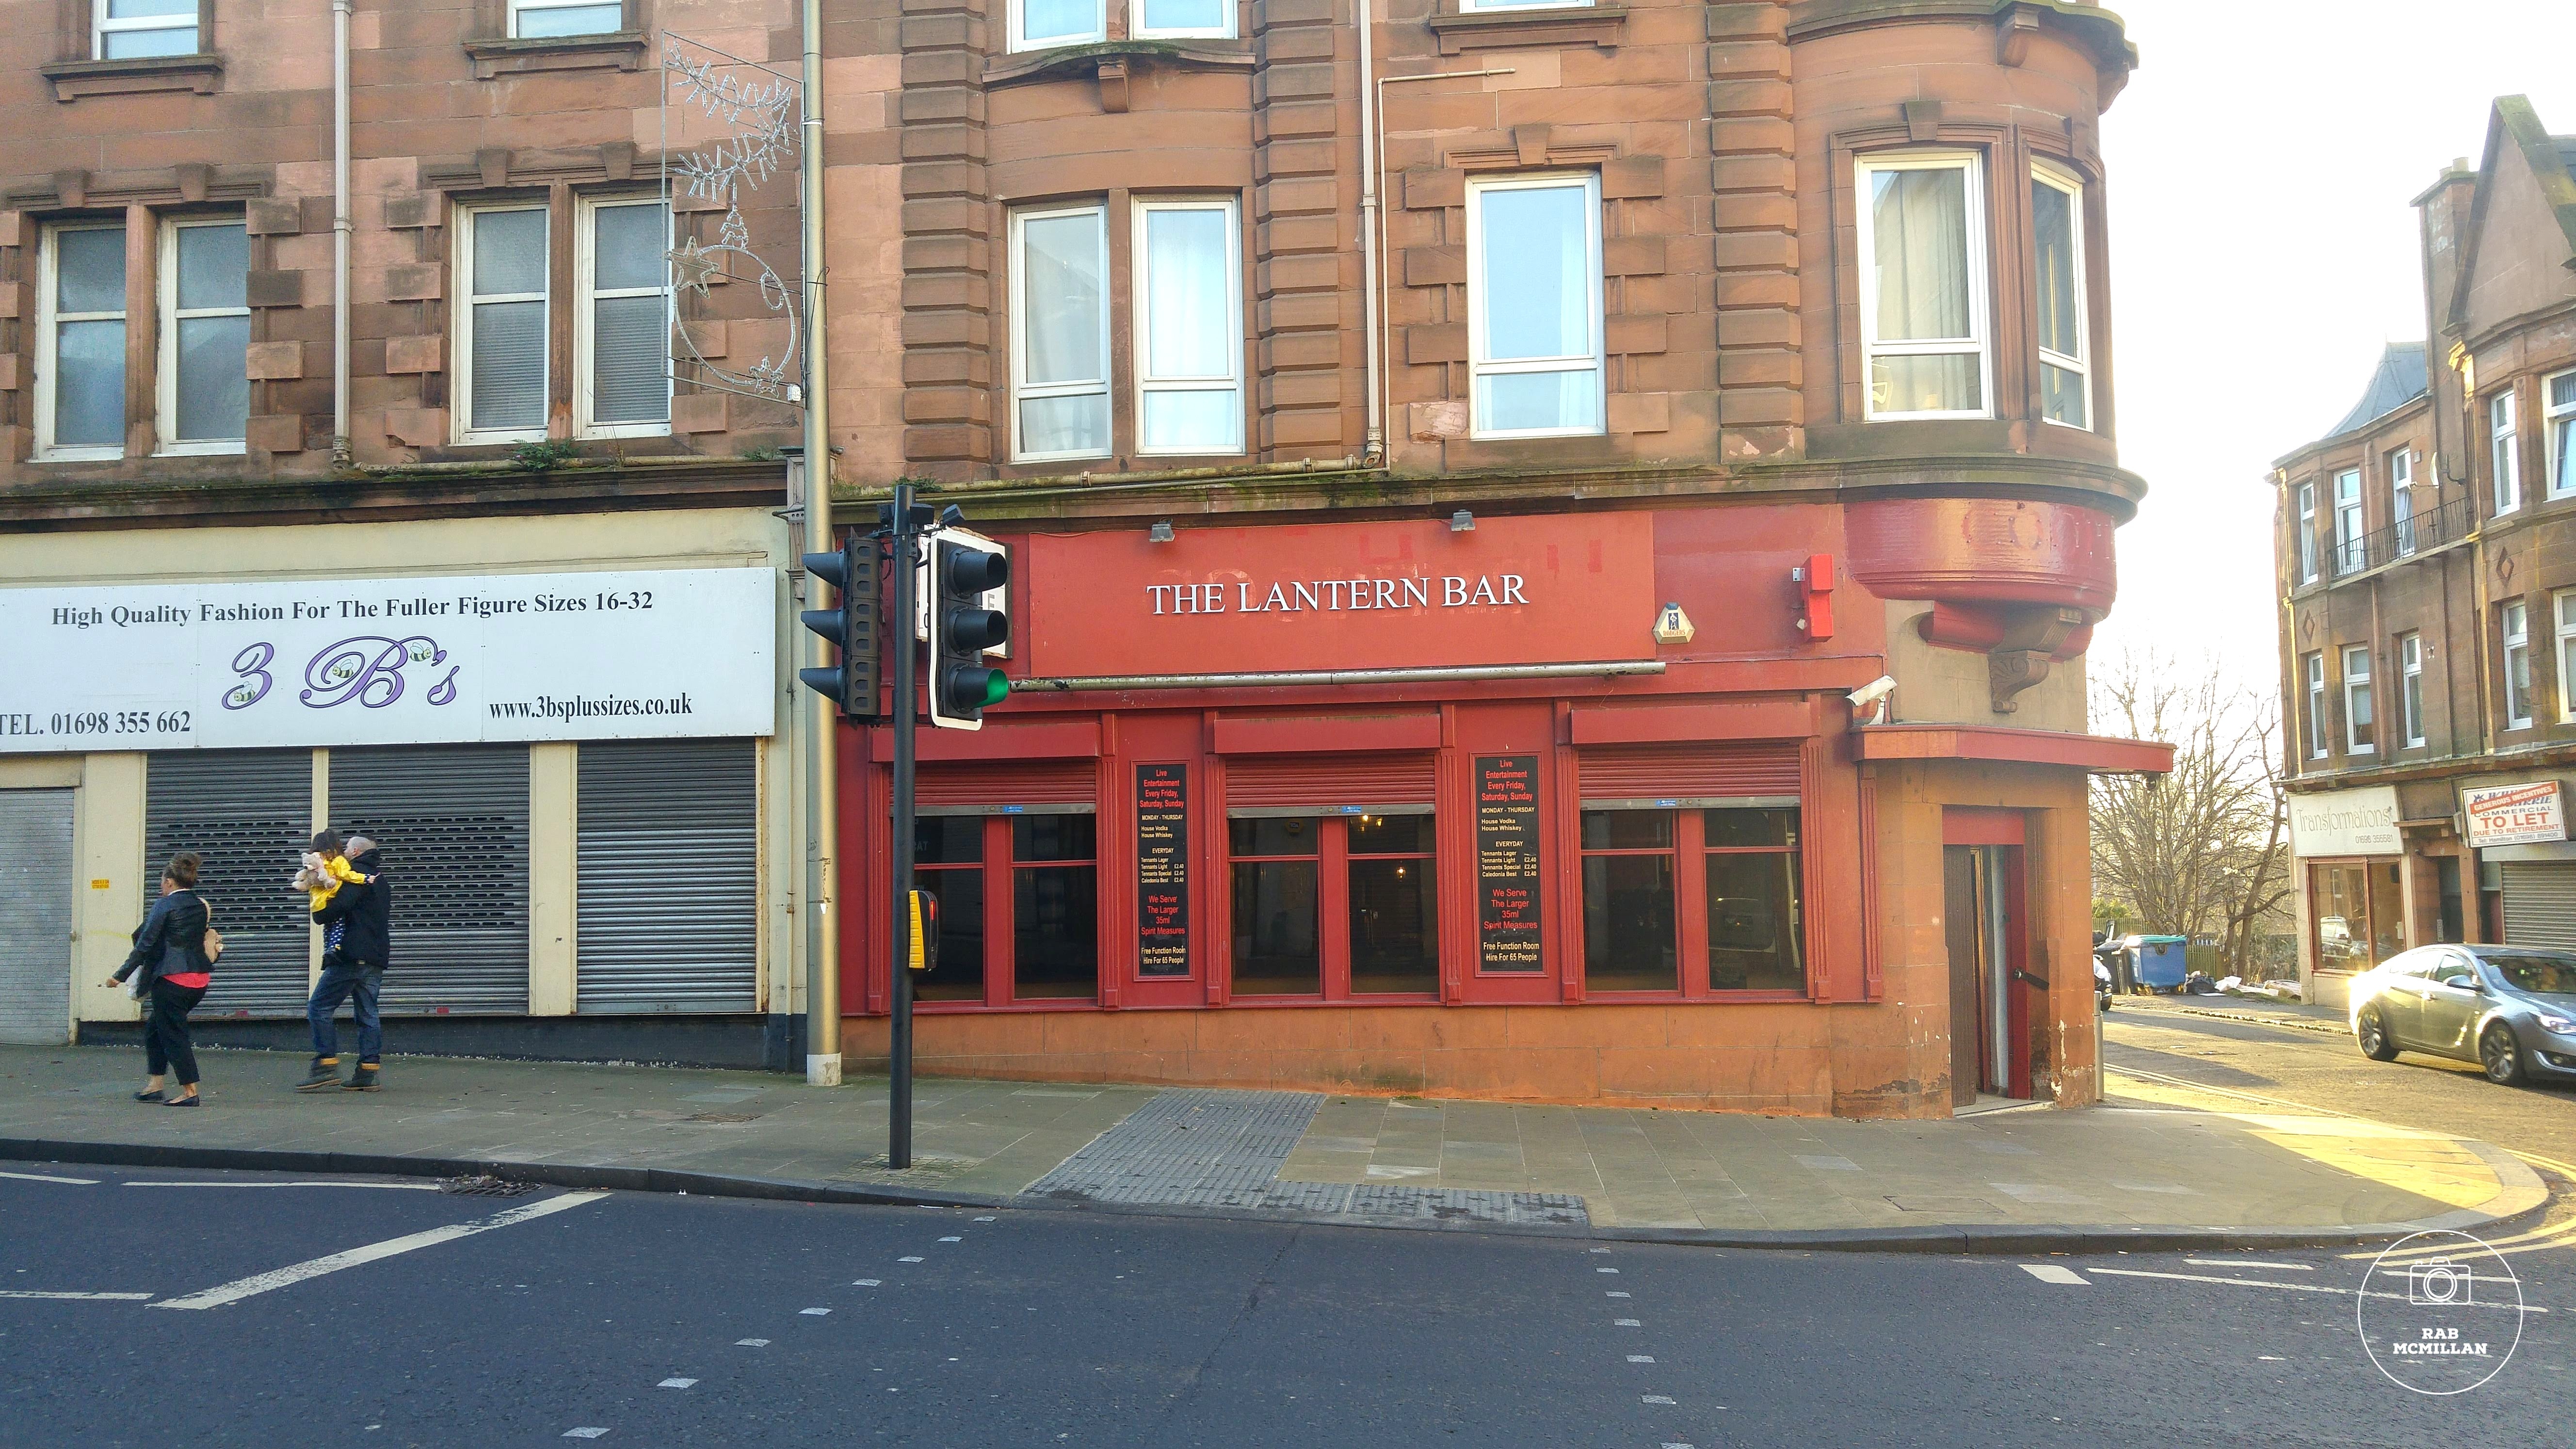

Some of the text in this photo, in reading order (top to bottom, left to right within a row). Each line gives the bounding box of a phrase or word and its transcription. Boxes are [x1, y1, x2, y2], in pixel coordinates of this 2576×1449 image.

[1146, 574, 1530, 614] THE LANTERN BAR
[51, 591, 653, 629] High Quality Fashion For The Fuller Figure Sizes 16-32
[222, 635, 460, 710] 3 B's
[489, 692, 693, 724] www.3bsplussizes.co.uk
[0, 710, 191, 735] TEL. 01698 355 662
[1488, 781, 1526, 790] Every Friday,
[1145, 789, 1178, 798] Every Friday,
[1481, 792, 1532, 802] Saturday, Sunday
[2474, 797, 2511, 811] GENEROUS
[2512, 786, 2553, 801] INCENTIVES
[1140, 800, 1184, 809] Saturday, Sunday
[2474, 806, 2554, 817] COMMERCIAL
[2296, 805, 2392, 836] Transformations
[2480, 812, 2549, 829] TO LET
[2506, 824, 2560, 833] RETIREMENT
[2355, 834, 2393, 844] 01698 355581
[1506, 900, 1529, 909] Larger
[1160, 906, 1178, 915] Larger
[1484, 921, 1501, 930] Spirit
[1141, 927, 1185, 936] Spirit Measures
[1518, 953, 1537, 962] People
